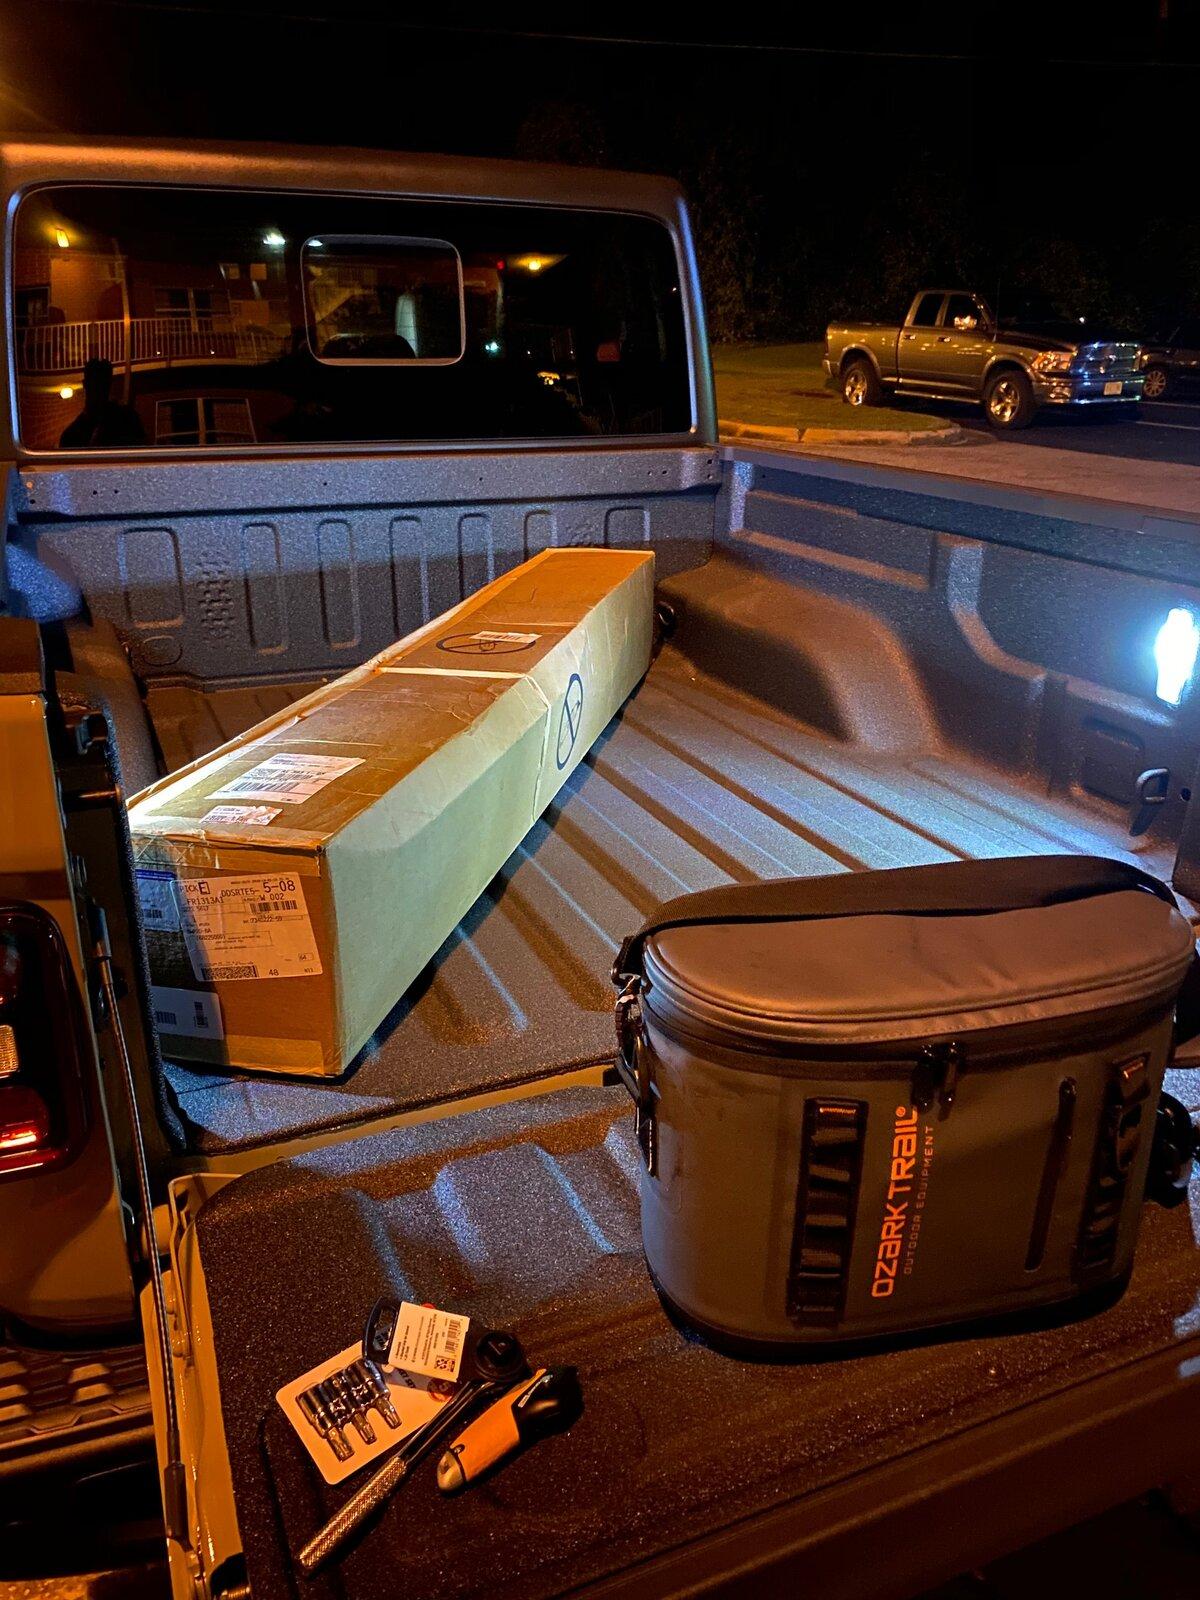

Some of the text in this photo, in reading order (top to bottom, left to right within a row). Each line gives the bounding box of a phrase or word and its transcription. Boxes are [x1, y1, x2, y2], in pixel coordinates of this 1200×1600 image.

[263, 880, 296, 894] 5-08
[903, 1125, 934, 1275] OUTDOOR EQUIPMENT
[871, 1201, 909, 1298] OZARK
